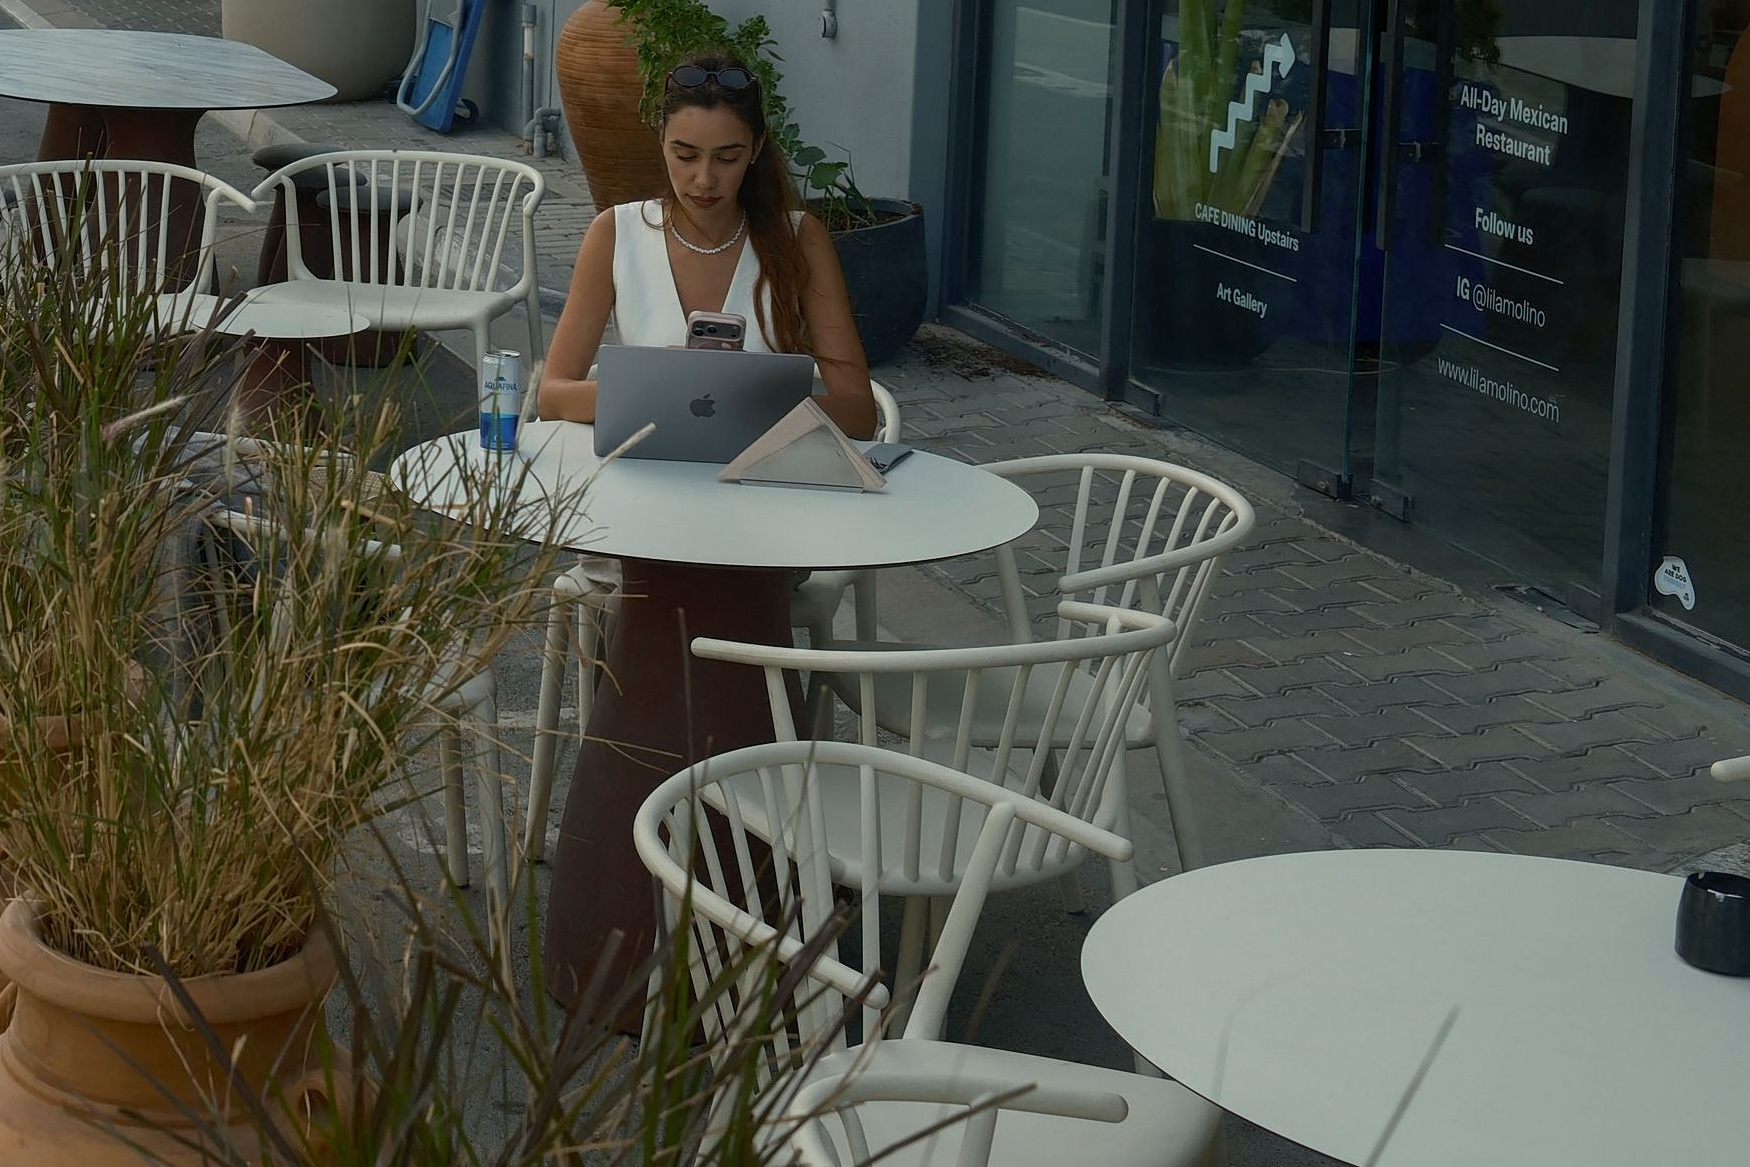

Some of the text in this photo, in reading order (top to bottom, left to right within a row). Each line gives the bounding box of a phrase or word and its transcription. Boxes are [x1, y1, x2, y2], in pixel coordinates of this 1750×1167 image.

[1460, 84, 1568, 135] All-Day Mexican
[1475, 123, 1550, 166] Restaurant
[1194, 202, 1299, 252] CAFE DINING Upstairs
[1475, 207, 1534, 246] Follow us
[1216, 282, 1268, 319] Art Gallery
[1456, 275, 1546, 328] IG @lilamolino
[484, 381, 518, 392] AQUAFINA
[1438, 357, 1560, 423] www.lilamolino.com
[1675, 573, 1687, 583] DOG
